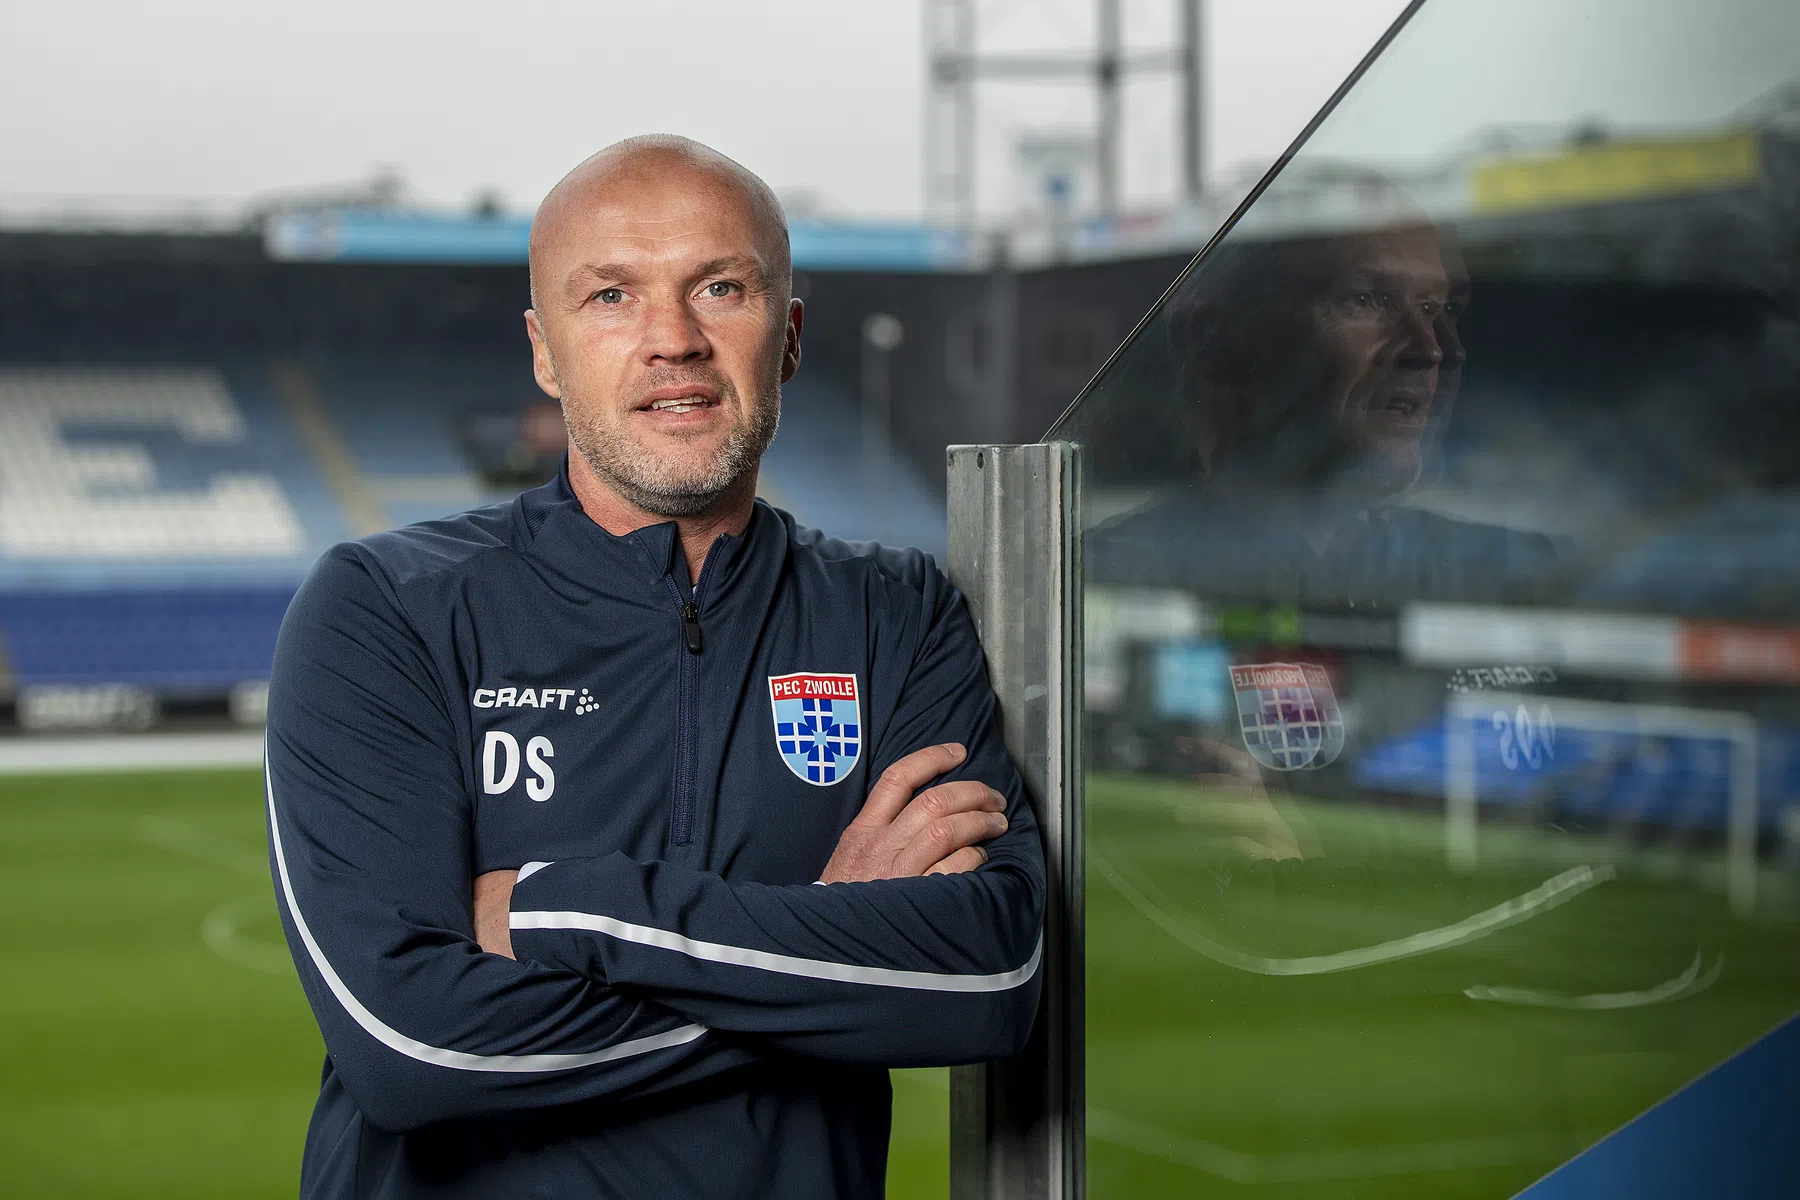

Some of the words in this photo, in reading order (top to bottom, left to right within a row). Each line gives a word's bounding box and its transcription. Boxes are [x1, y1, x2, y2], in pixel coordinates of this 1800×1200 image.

[473, 687, 575, 710] CRAFT
[774, 680, 800, 696] PEC
[804, 680, 853, 696] ZWOLLE
[483, 730, 555, 802] DS
